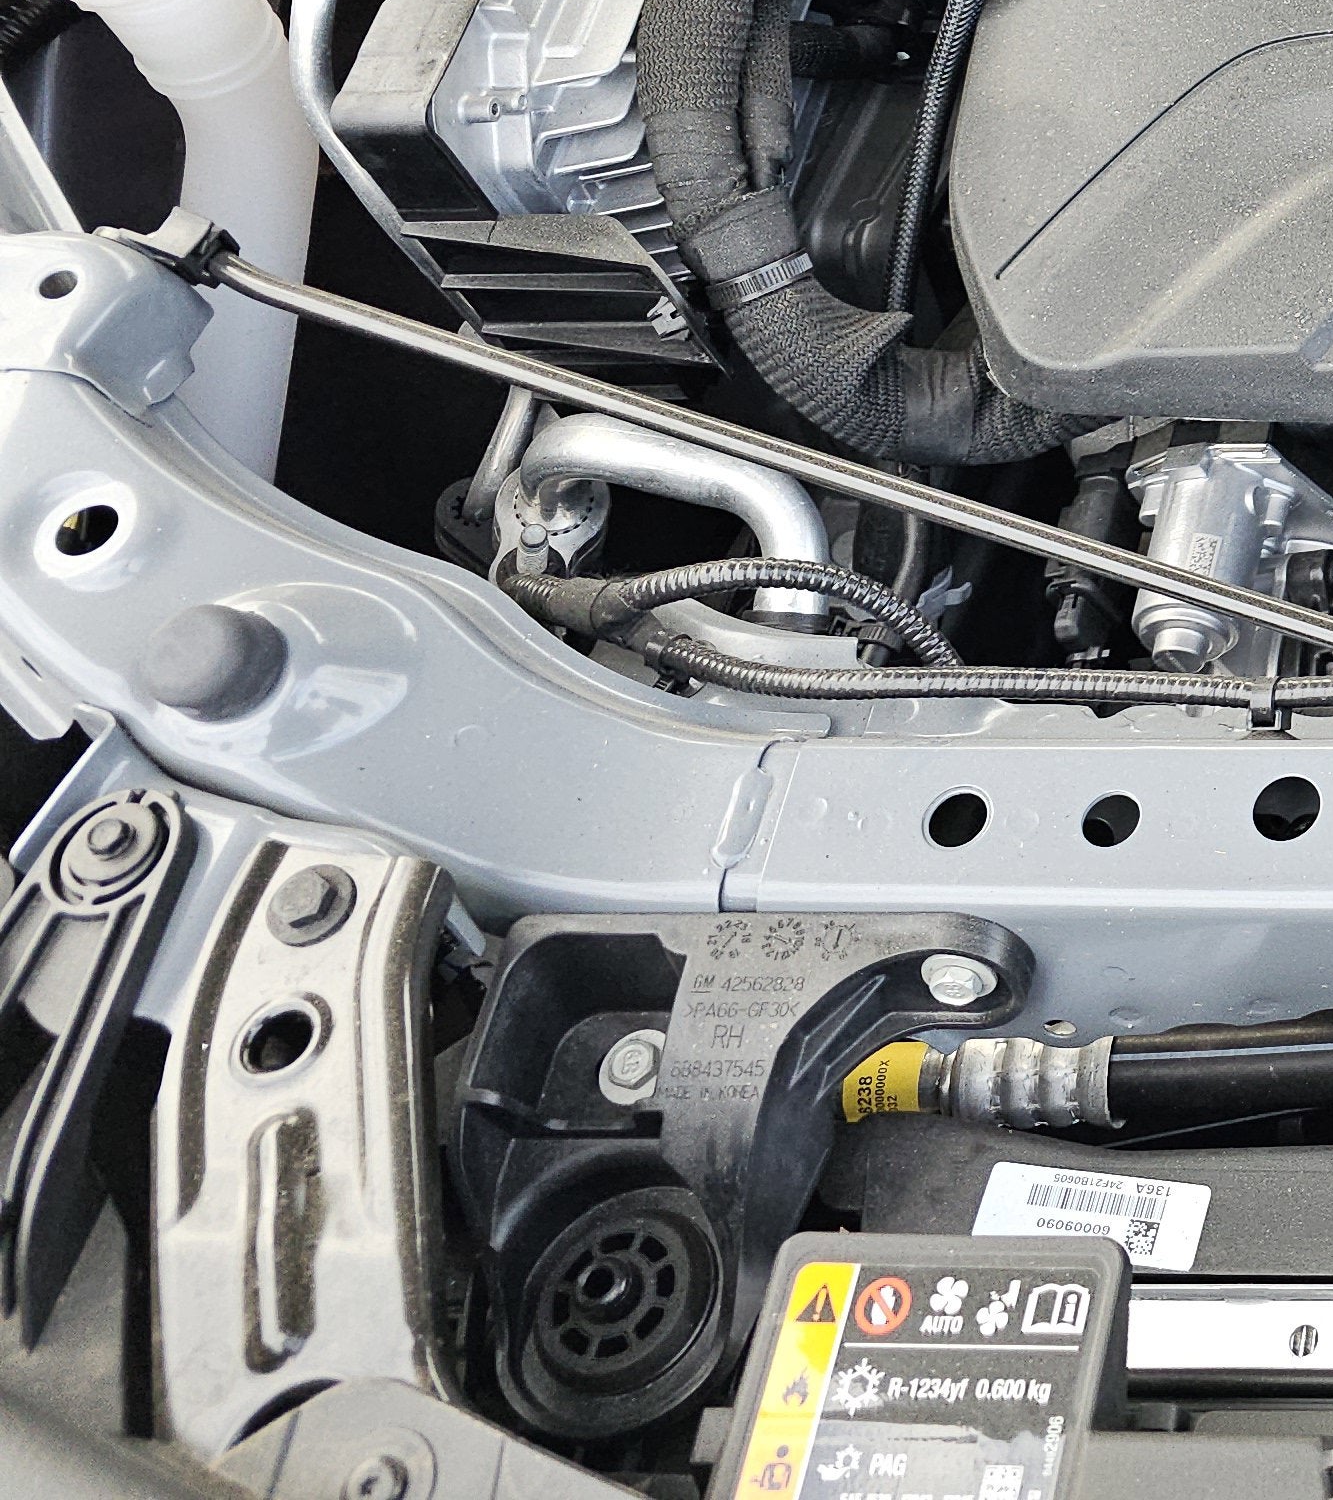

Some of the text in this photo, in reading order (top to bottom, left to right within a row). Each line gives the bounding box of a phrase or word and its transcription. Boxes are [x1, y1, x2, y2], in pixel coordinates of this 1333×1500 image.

[720, 975, 806, 992] 42562828
[711, 1024, 745, 1049] RH
[1053, 1173, 1171, 1197] 136A 24F21B0605
[1036, 1217, 1111, 1235] 60009090
[919, 1315, 964, 1335] AUTO
[887, 1376, 1052, 1406] R-1234yf 0.600 kg
[869, 1453, 908, 1478] PAG
